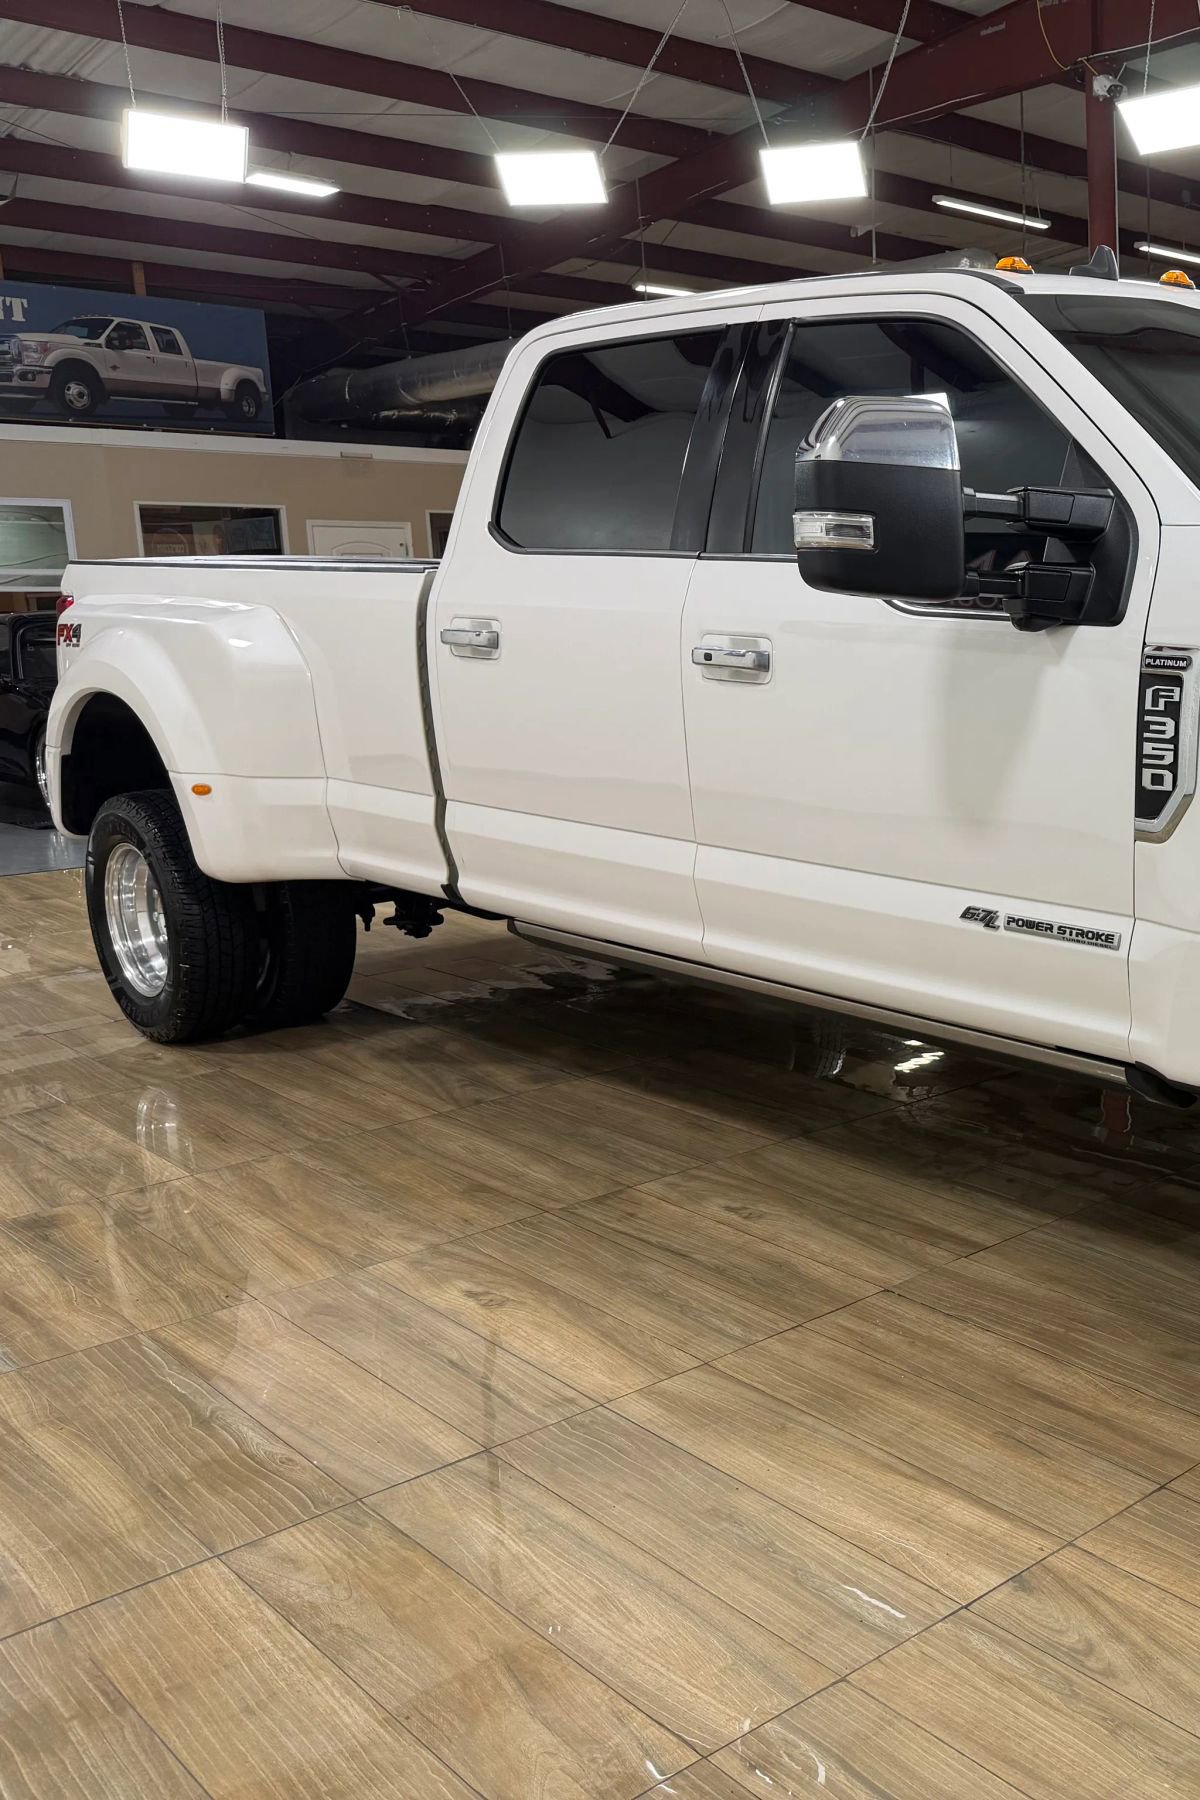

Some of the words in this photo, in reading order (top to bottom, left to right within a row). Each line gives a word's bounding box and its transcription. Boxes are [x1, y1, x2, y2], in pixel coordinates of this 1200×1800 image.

[57, 623, 82, 646] FX4
[1145, 657, 1187, 668] PLATINUM
[1141, 685, 1181, 792] F350
[1006, 915, 1054, 934] POWER
[1056, 925, 1115, 945] STROKE
[1061, 936, 1087, 945] TURBO
